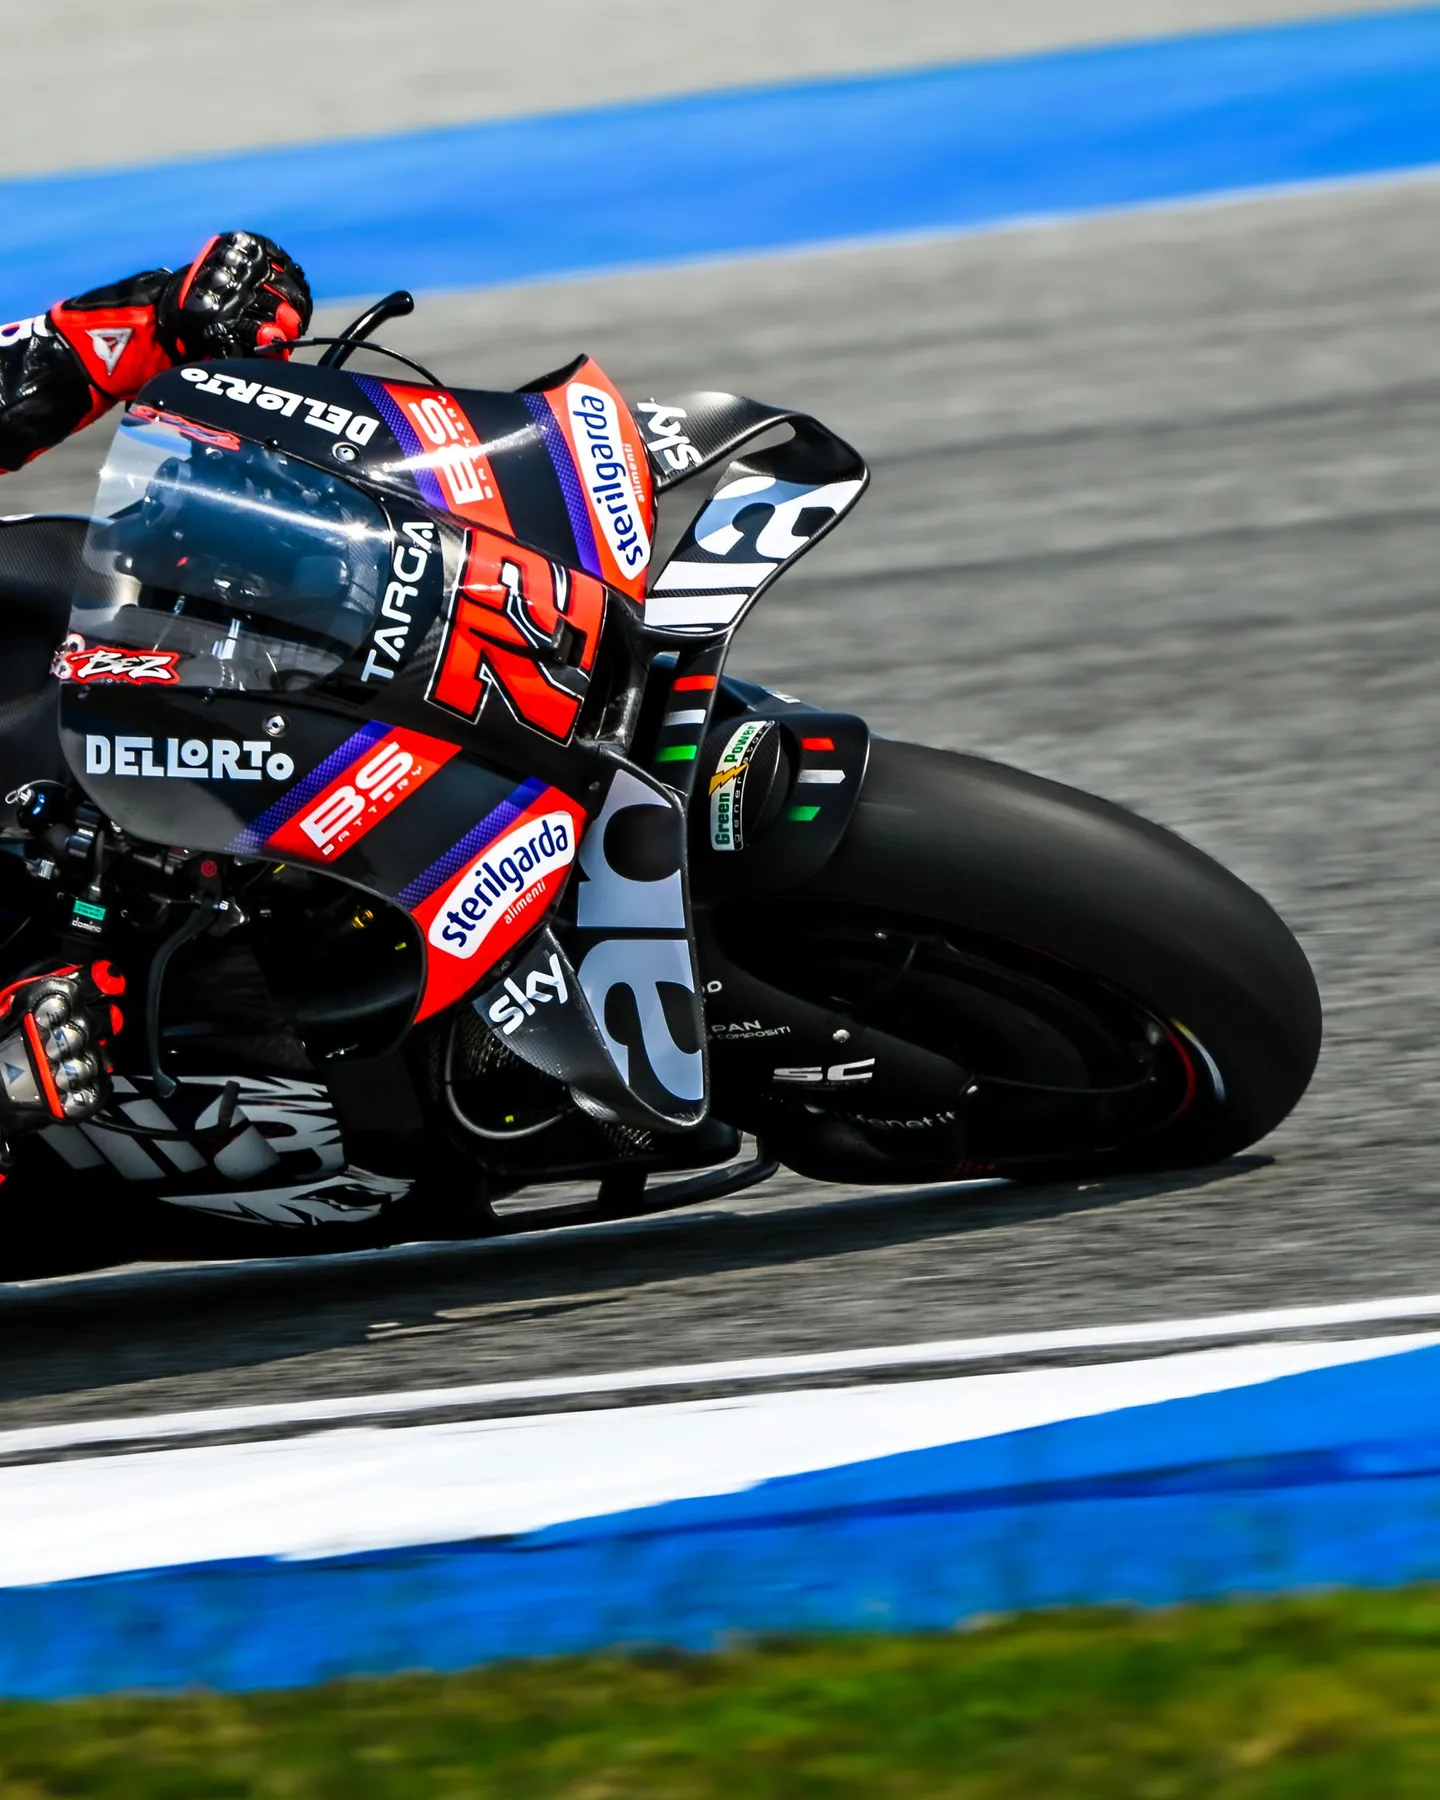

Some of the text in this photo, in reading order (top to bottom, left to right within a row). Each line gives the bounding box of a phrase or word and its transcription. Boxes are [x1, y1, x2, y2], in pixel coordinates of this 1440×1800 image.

[573, 395, 643, 566] sterilgarda
[623, 443, 646, 503] alimenti
[361, 521, 435, 683] TARGA
[424, 527, 608, 746] 72
[70, 650, 172, 679] BEZ
[299, 741, 414, 849] BS
[322, 765, 423, 856] BATTERY
[714, 725, 757, 845] Green Power
[71, 916, 102, 933] domino
[441, 819, 569, 948] sterilgarda
[503, 877, 547, 925] alimenti
[489, 953, 568, 1035] sky
[717, 1026, 791, 1041] COMPOSITI
[773, 1058, 875, 1082] SC
